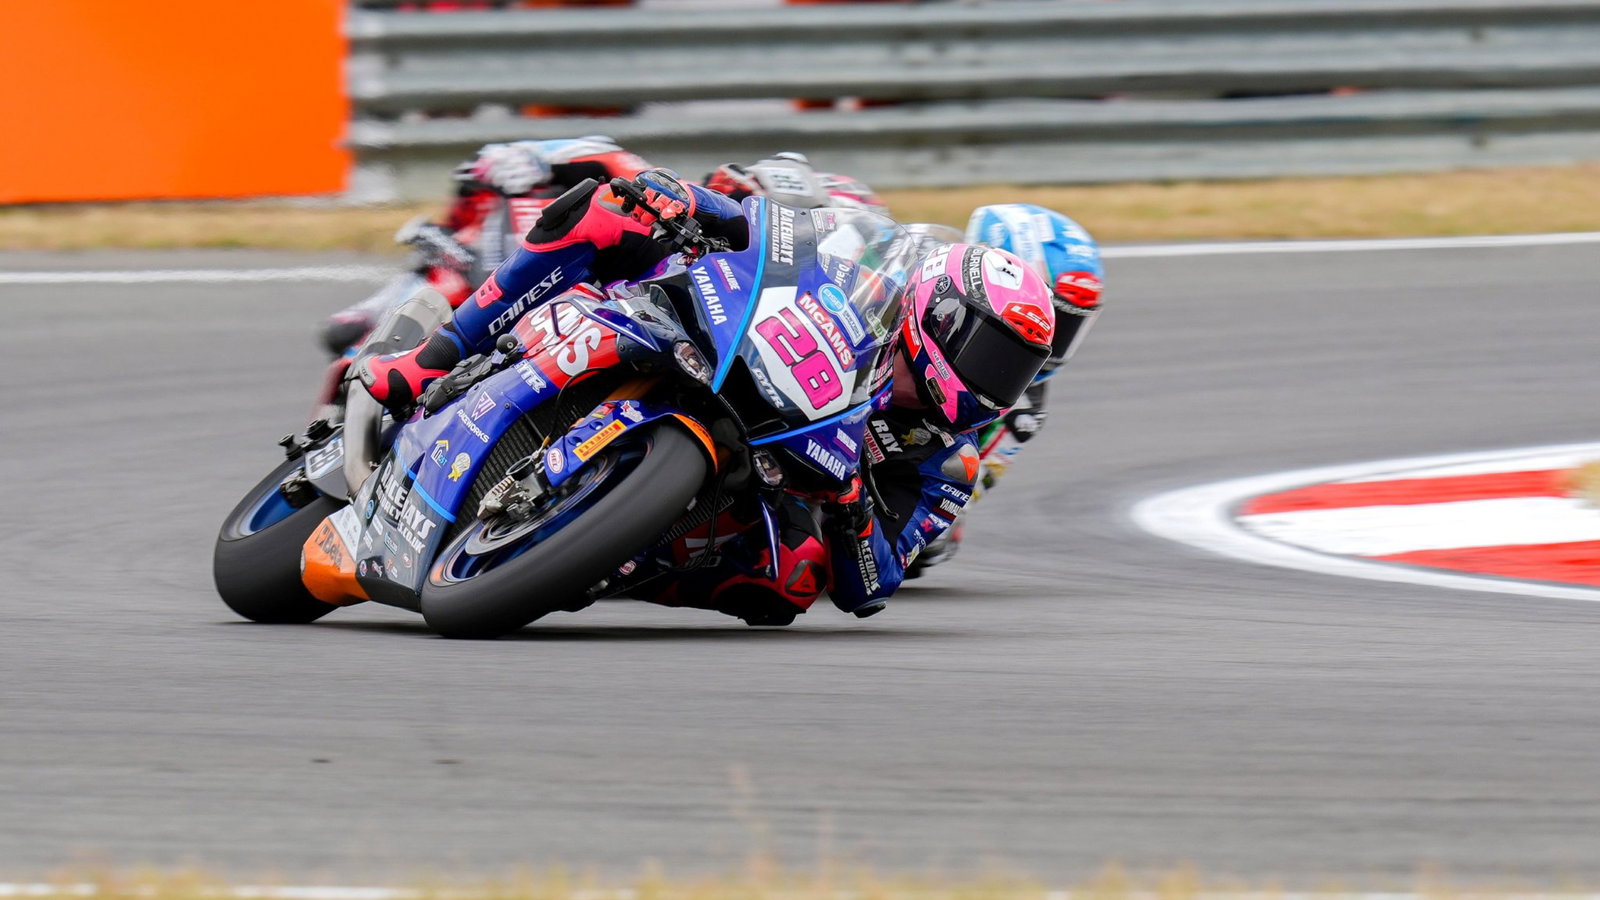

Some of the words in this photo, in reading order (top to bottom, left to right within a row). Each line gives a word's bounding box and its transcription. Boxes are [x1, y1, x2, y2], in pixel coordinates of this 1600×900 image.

[780, 206, 795, 266] RACEWAYS
[969, 248, 982, 292] BURNELL
[488, 265, 564, 336] DAINESE
[692, 266, 727, 325] YAMAHA
[1010, 305, 1051, 332] LS2
[755, 306, 843, 410] 28
[752, 368, 785, 409] GYTR
[456, 409, 490, 444] RACEWORKS
[871, 419, 903, 453] RAY
[806, 439, 847, 481] YAMAHA
[866, 433, 884, 463] YAMAHA
